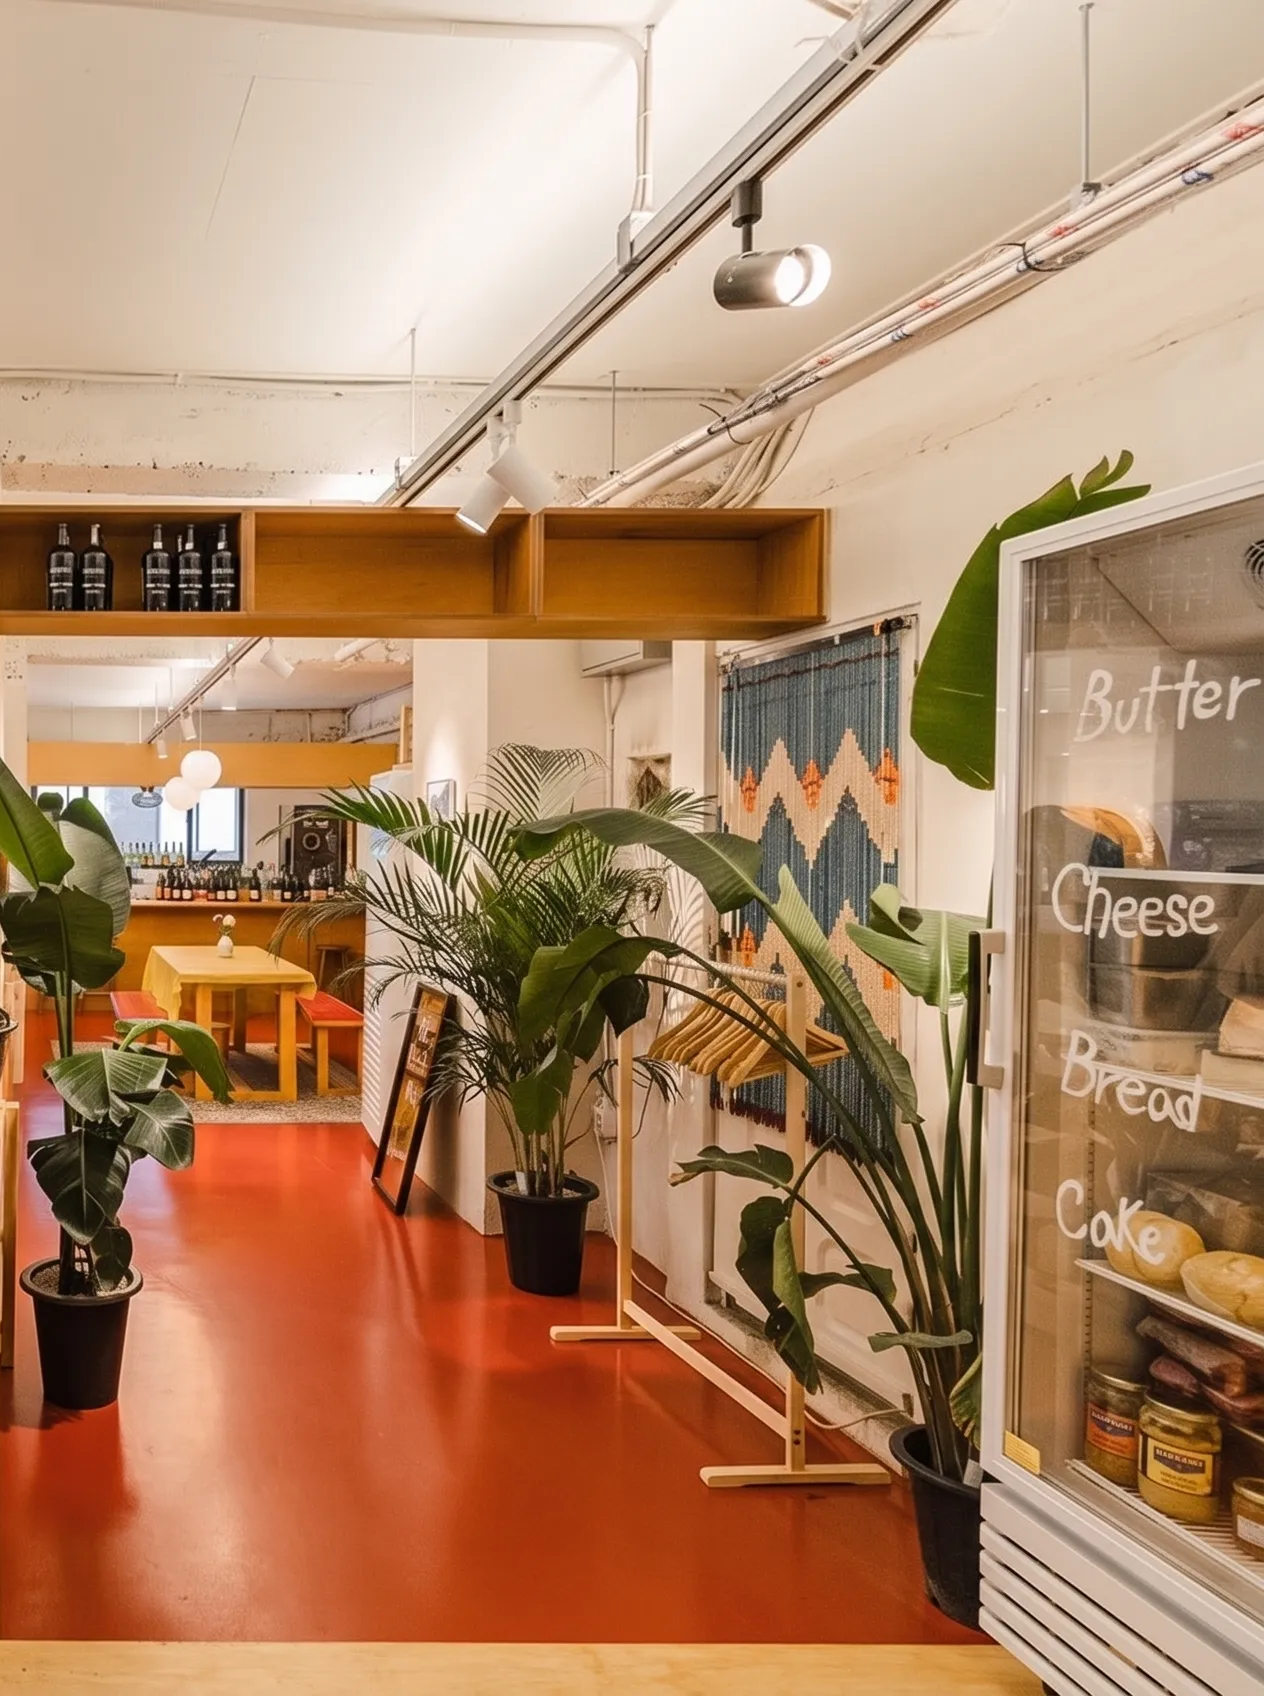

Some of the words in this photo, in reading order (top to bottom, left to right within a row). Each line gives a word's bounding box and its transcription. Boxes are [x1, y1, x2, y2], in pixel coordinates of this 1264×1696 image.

[1073, 658, 1262, 742] Butter
[1051, 862, 1219, 939] Cheese
[1060, 1028, 1203, 1133] Bread
[1055, 1178, 1166, 1266] Cake
